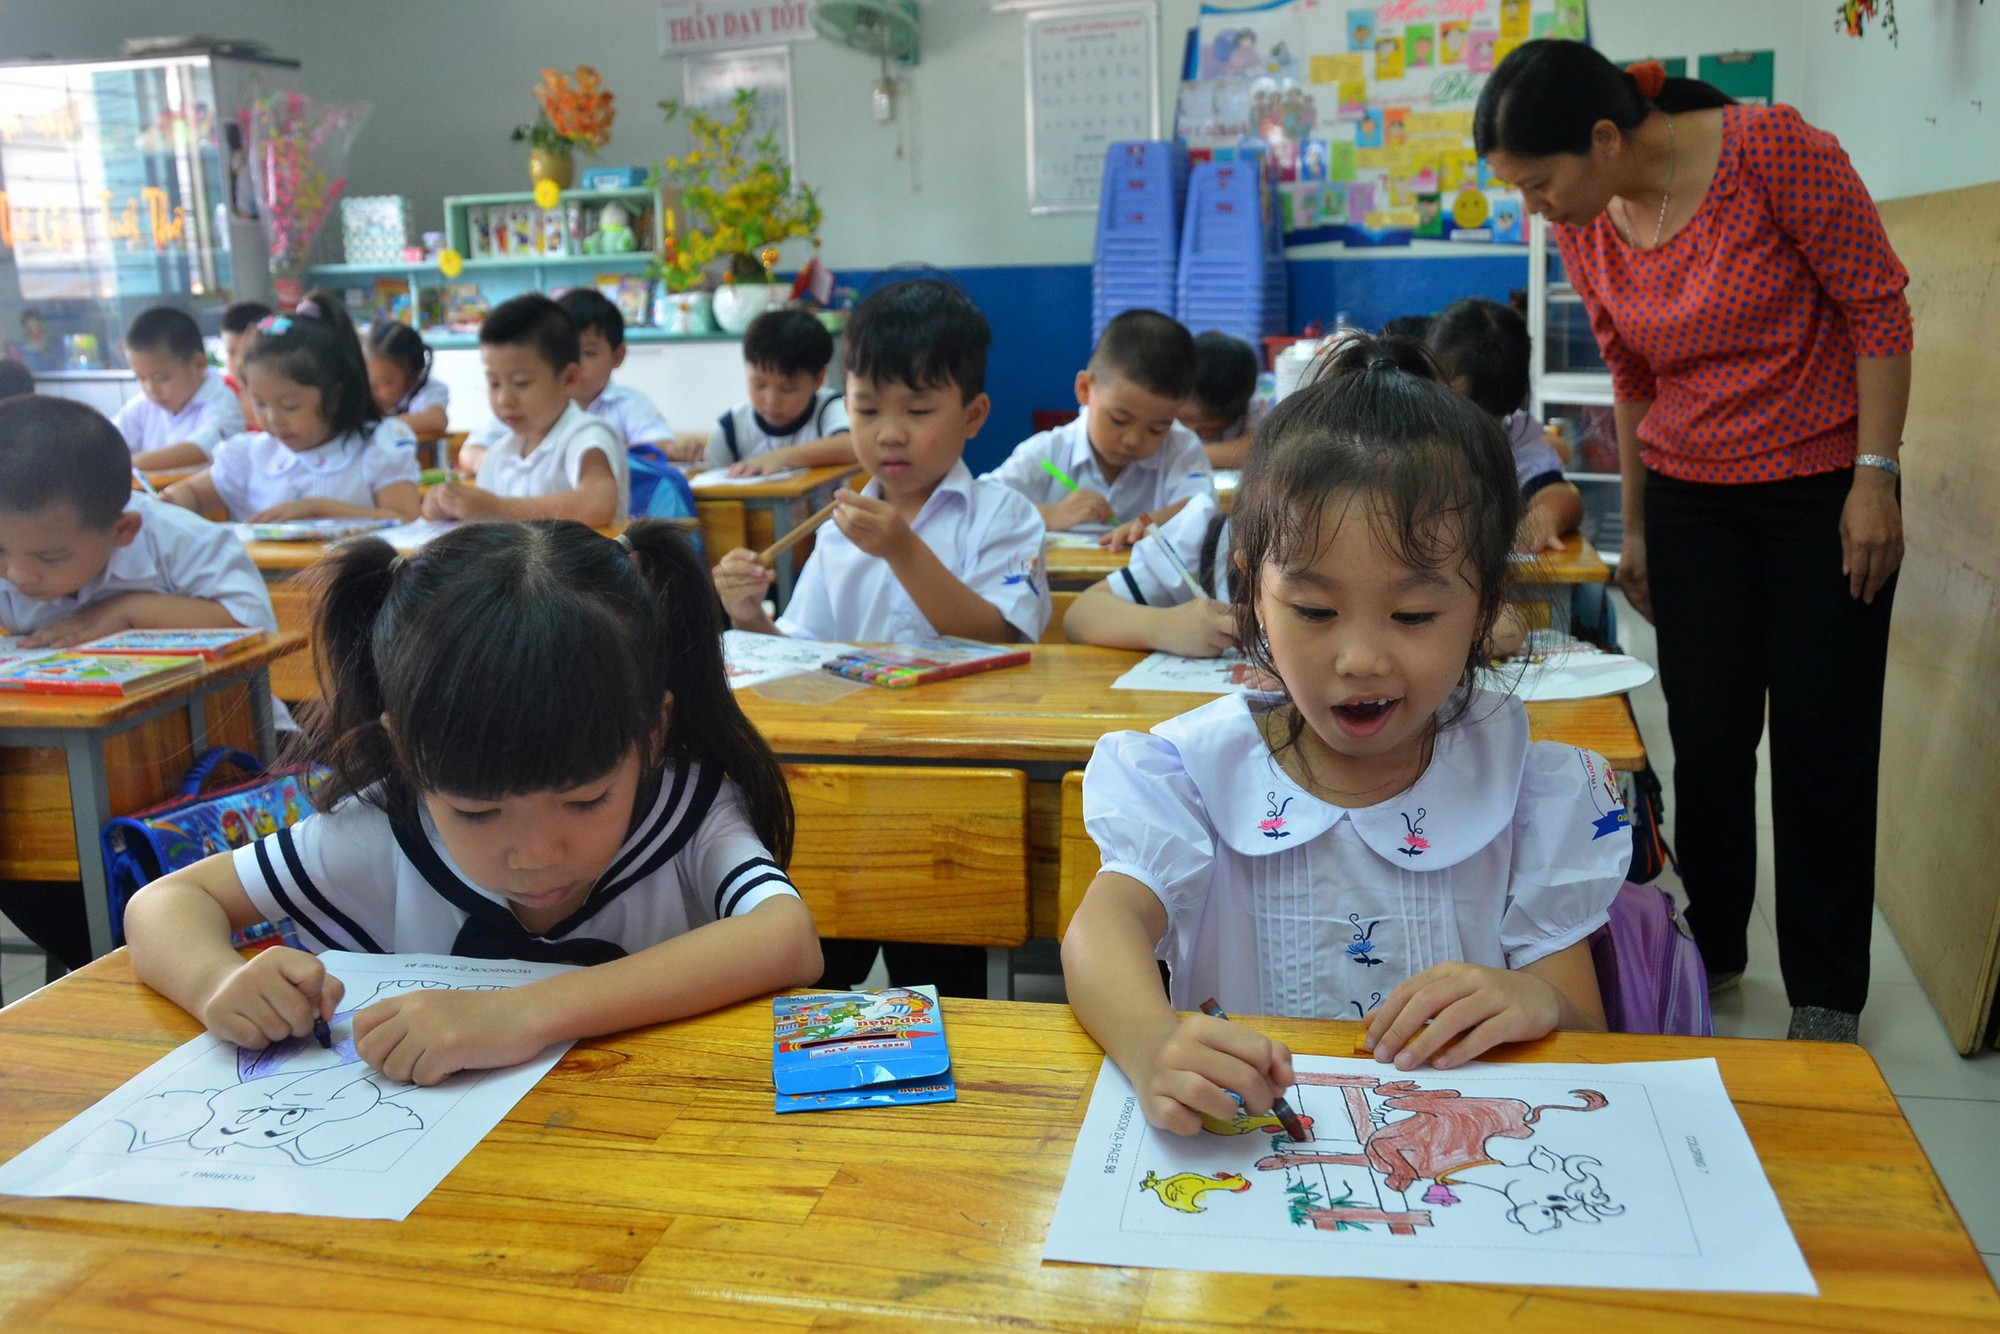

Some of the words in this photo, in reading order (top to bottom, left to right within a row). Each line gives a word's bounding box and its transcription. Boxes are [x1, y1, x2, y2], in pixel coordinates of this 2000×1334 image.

[1117, 1096, 1136, 1131] WORKBOOK
[1106, 1143, 1122, 1163] PAGE
[1685, 1135, 1707, 1167] COLORING
[193, 1171, 256, 1181] COLORING
[1104, 1165, 1116, 1174] 98
